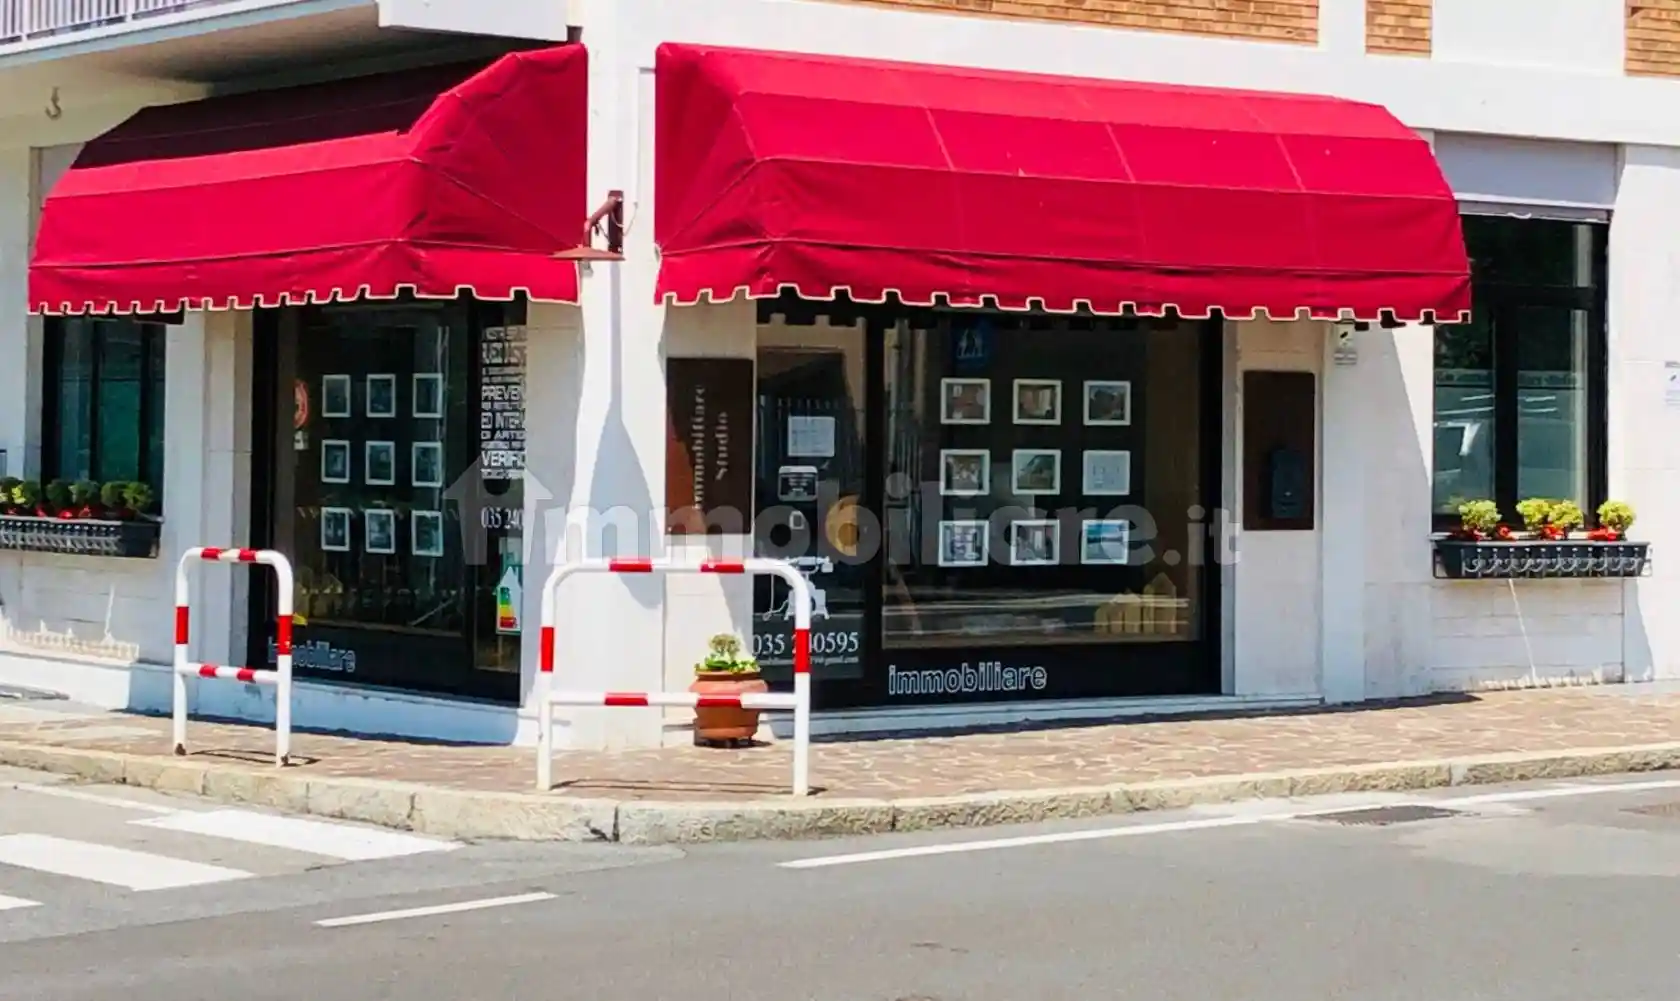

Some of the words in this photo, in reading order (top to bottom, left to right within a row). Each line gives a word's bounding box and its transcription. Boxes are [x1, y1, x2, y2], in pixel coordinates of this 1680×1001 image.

[714, 411, 729, 481] Studio
[481, 506, 502, 529] 035
[753, 633, 786, 656] 035
[791, 632, 859, 655] 0595
[888, 660, 1048, 695] immobiliare
